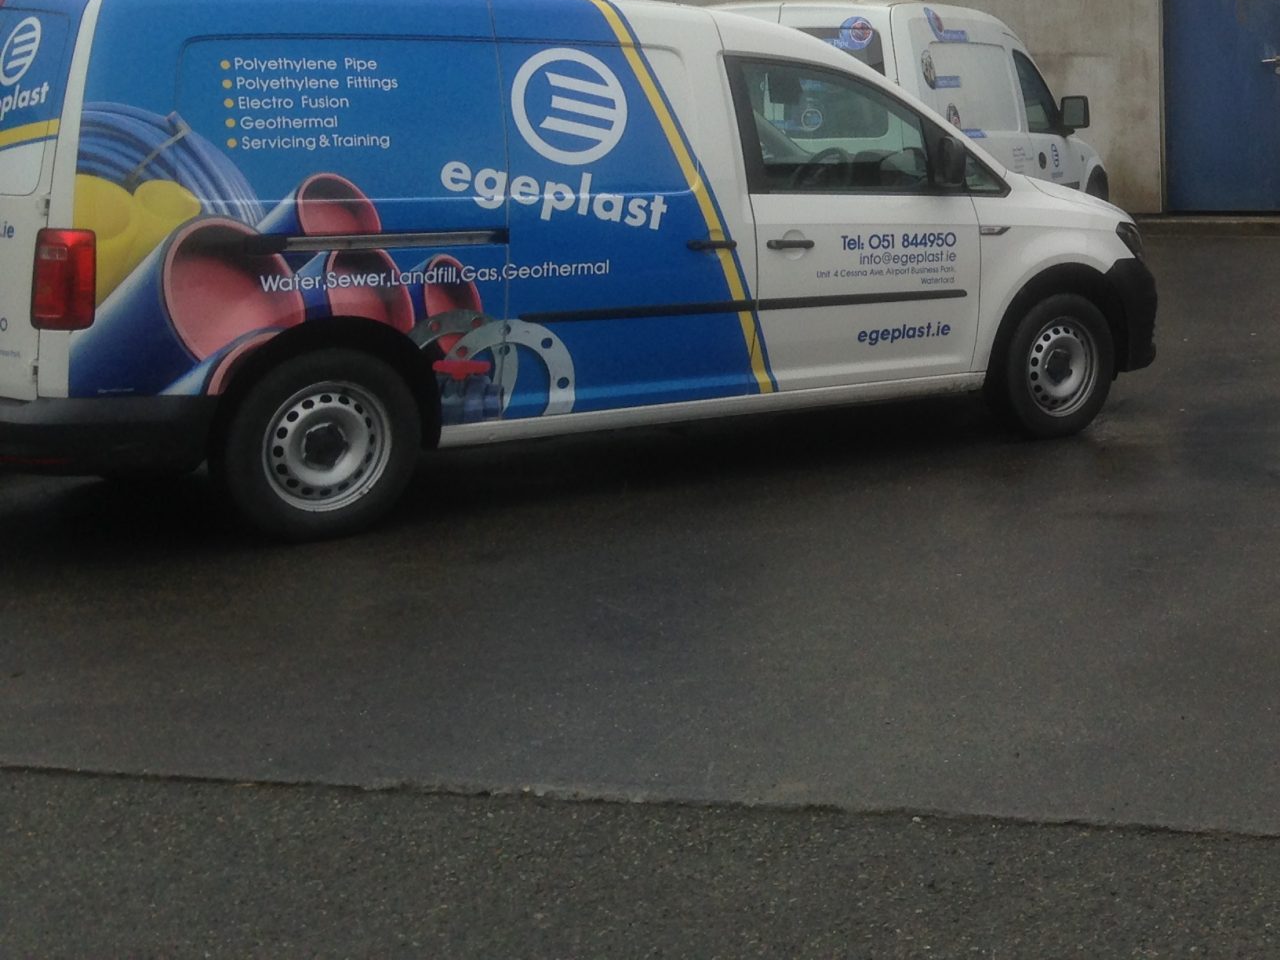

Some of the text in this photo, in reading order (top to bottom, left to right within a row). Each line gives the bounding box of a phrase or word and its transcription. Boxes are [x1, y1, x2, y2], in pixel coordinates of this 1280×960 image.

[234, 57, 378, 72] Polyethylene Pipe
[236, 76, 399, 92] Polyethylene Fittings
[0, 81, 49, 120] plast
[238, 96, 350, 110] Electro Fusion
[240, 115, 338, 130] Geothermal
[242, 134, 390, 150] Servicing & Training
[440, 160, 668, 230] egeplast
[841, 232, 957, 250] Tel: 051 844950
[860, 250, 957, 266] info@egeplast.ie
[816, 270, 830, 278] Unit
[840, 269, 868, 277] Cessna
[885, 267, 910, 276] Airport
[910, 266, 939, 275] Business
[920, 276, 955, 285] Waterford
[857, 322, 951, 346] egeplast.ie
